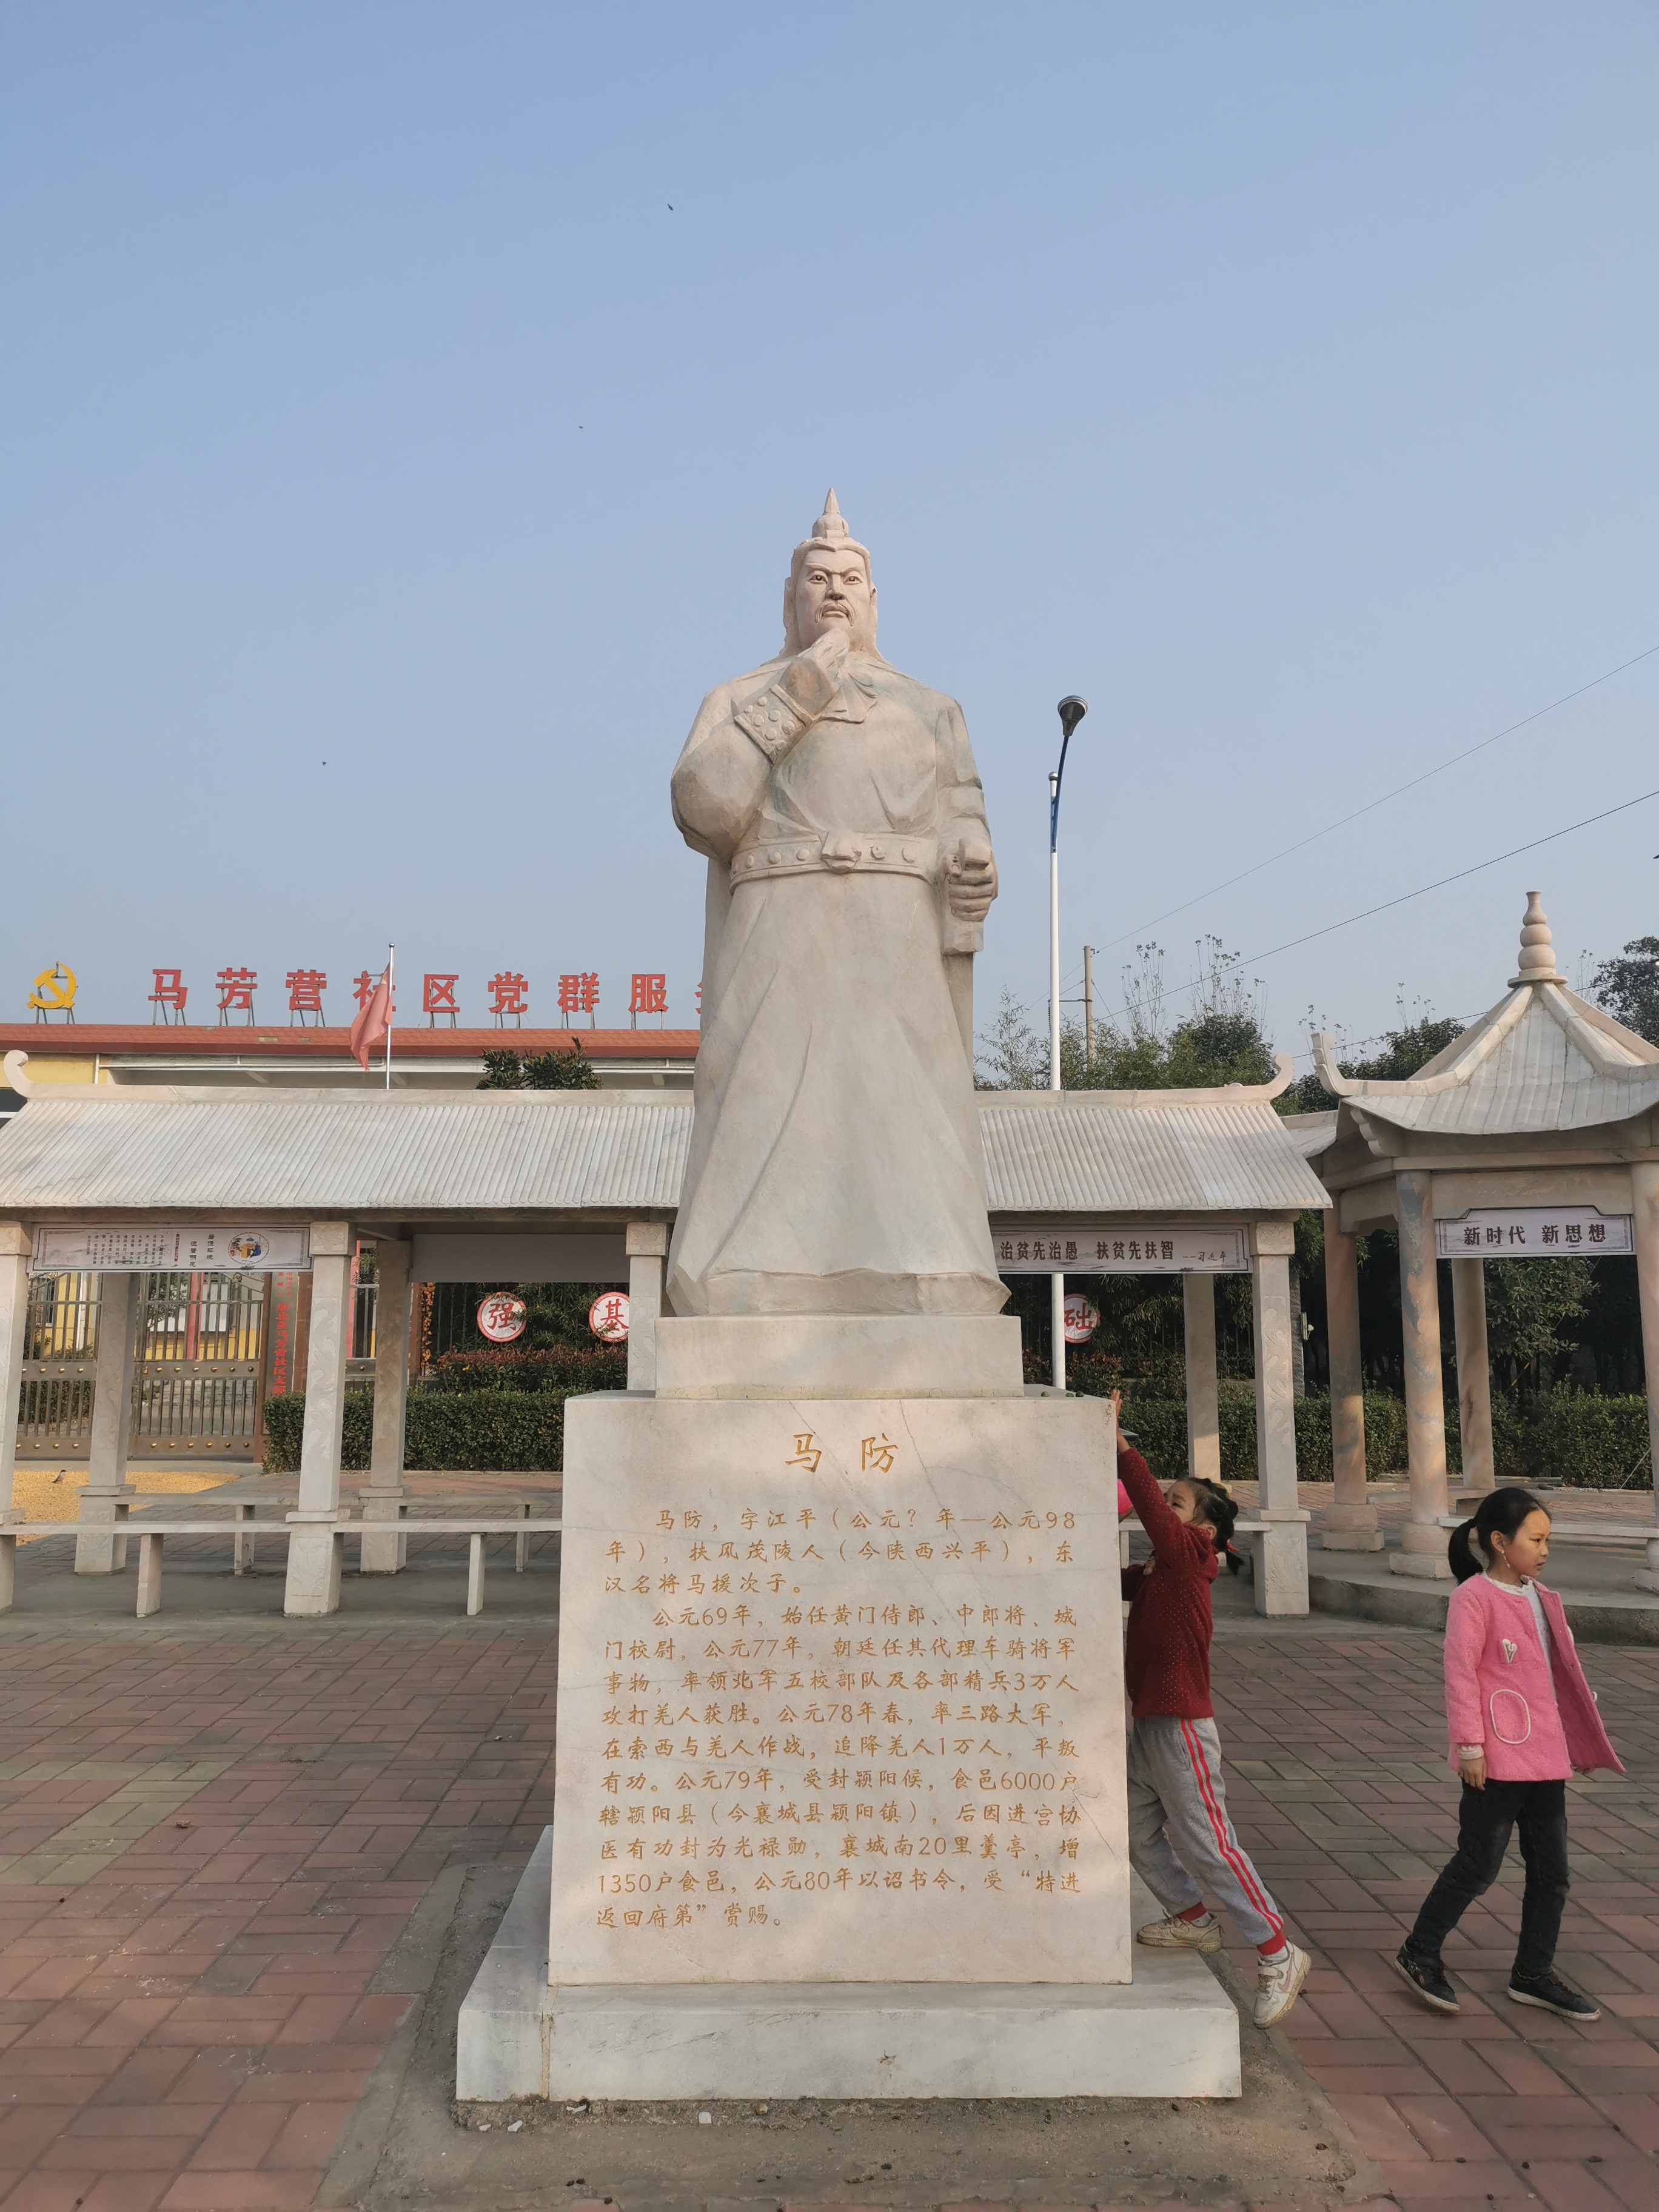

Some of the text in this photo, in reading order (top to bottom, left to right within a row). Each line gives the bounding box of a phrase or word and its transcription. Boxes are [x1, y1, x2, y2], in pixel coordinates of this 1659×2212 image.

[147, 968, 703, 1014] 马芳营社区党群服
[1463, 1223, 1606, 1245] 新时代 新思想
[1000, 1241, 1078, 1261] 治贫先治愚
[1096, 1240, 1174, 1261] 扶贫先扶智
[486, 1302, 516, 1332] 强
[600, 1298, 629, 1332] 基
[1064, 1302, 1093, 1330] 础
[785, 1433, 898, 1473] 马防
[605, 1572, 802, 1595] 汉名将马援次子。
